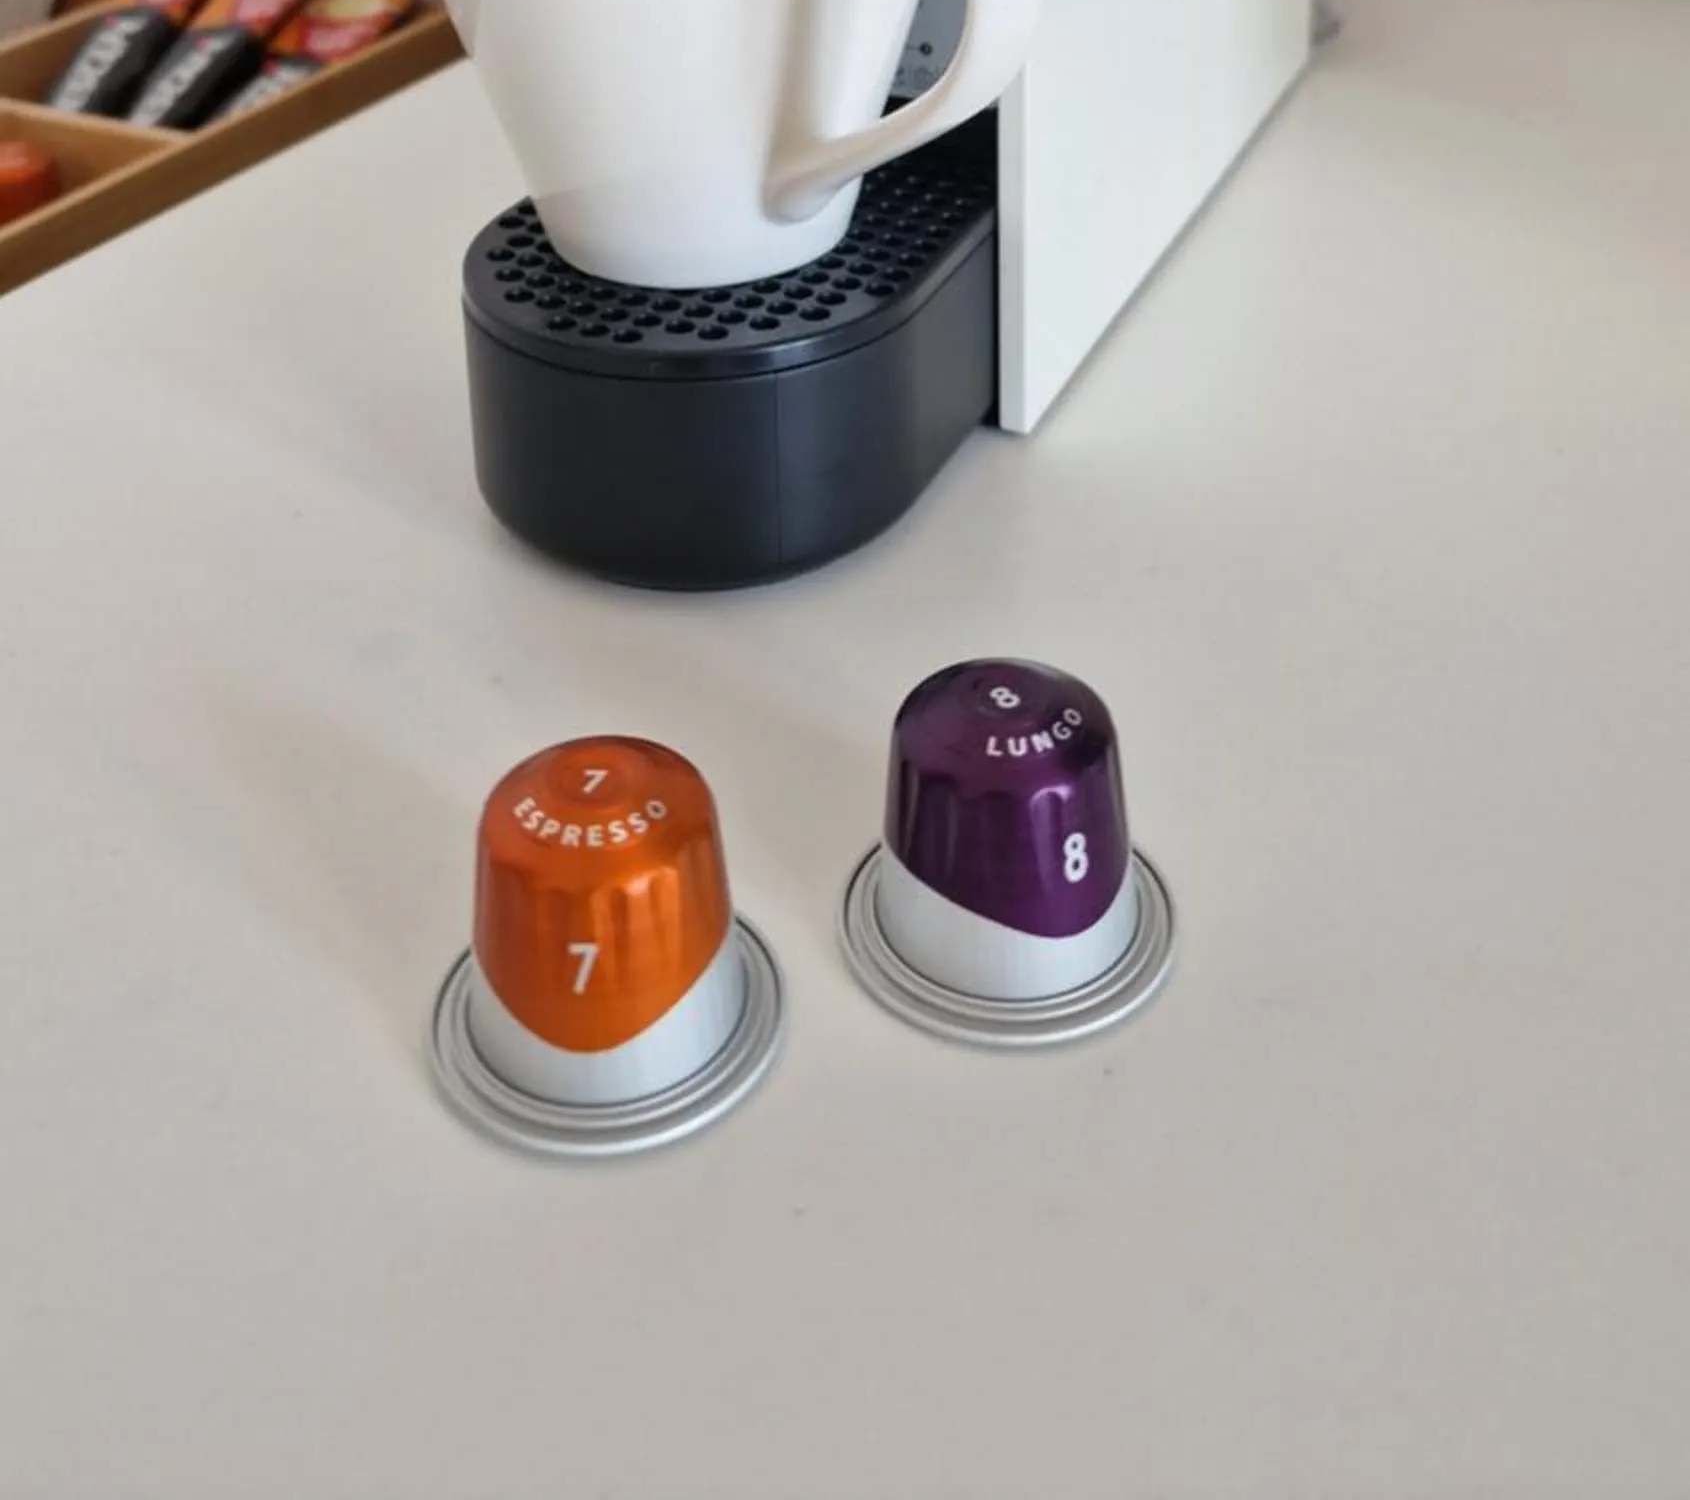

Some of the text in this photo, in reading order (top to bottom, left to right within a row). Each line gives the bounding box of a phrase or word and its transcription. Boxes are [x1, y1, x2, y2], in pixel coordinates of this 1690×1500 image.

[989, 686, 1020, 709] 8
[985, 708, 1083, 757] LUNGO
[582, 769, 609, 794] 7
[512, 796, 668, 848] ESPRESSO
[1063, 832, 1089, 884] 8
[567, 942, 599, 995] 7
